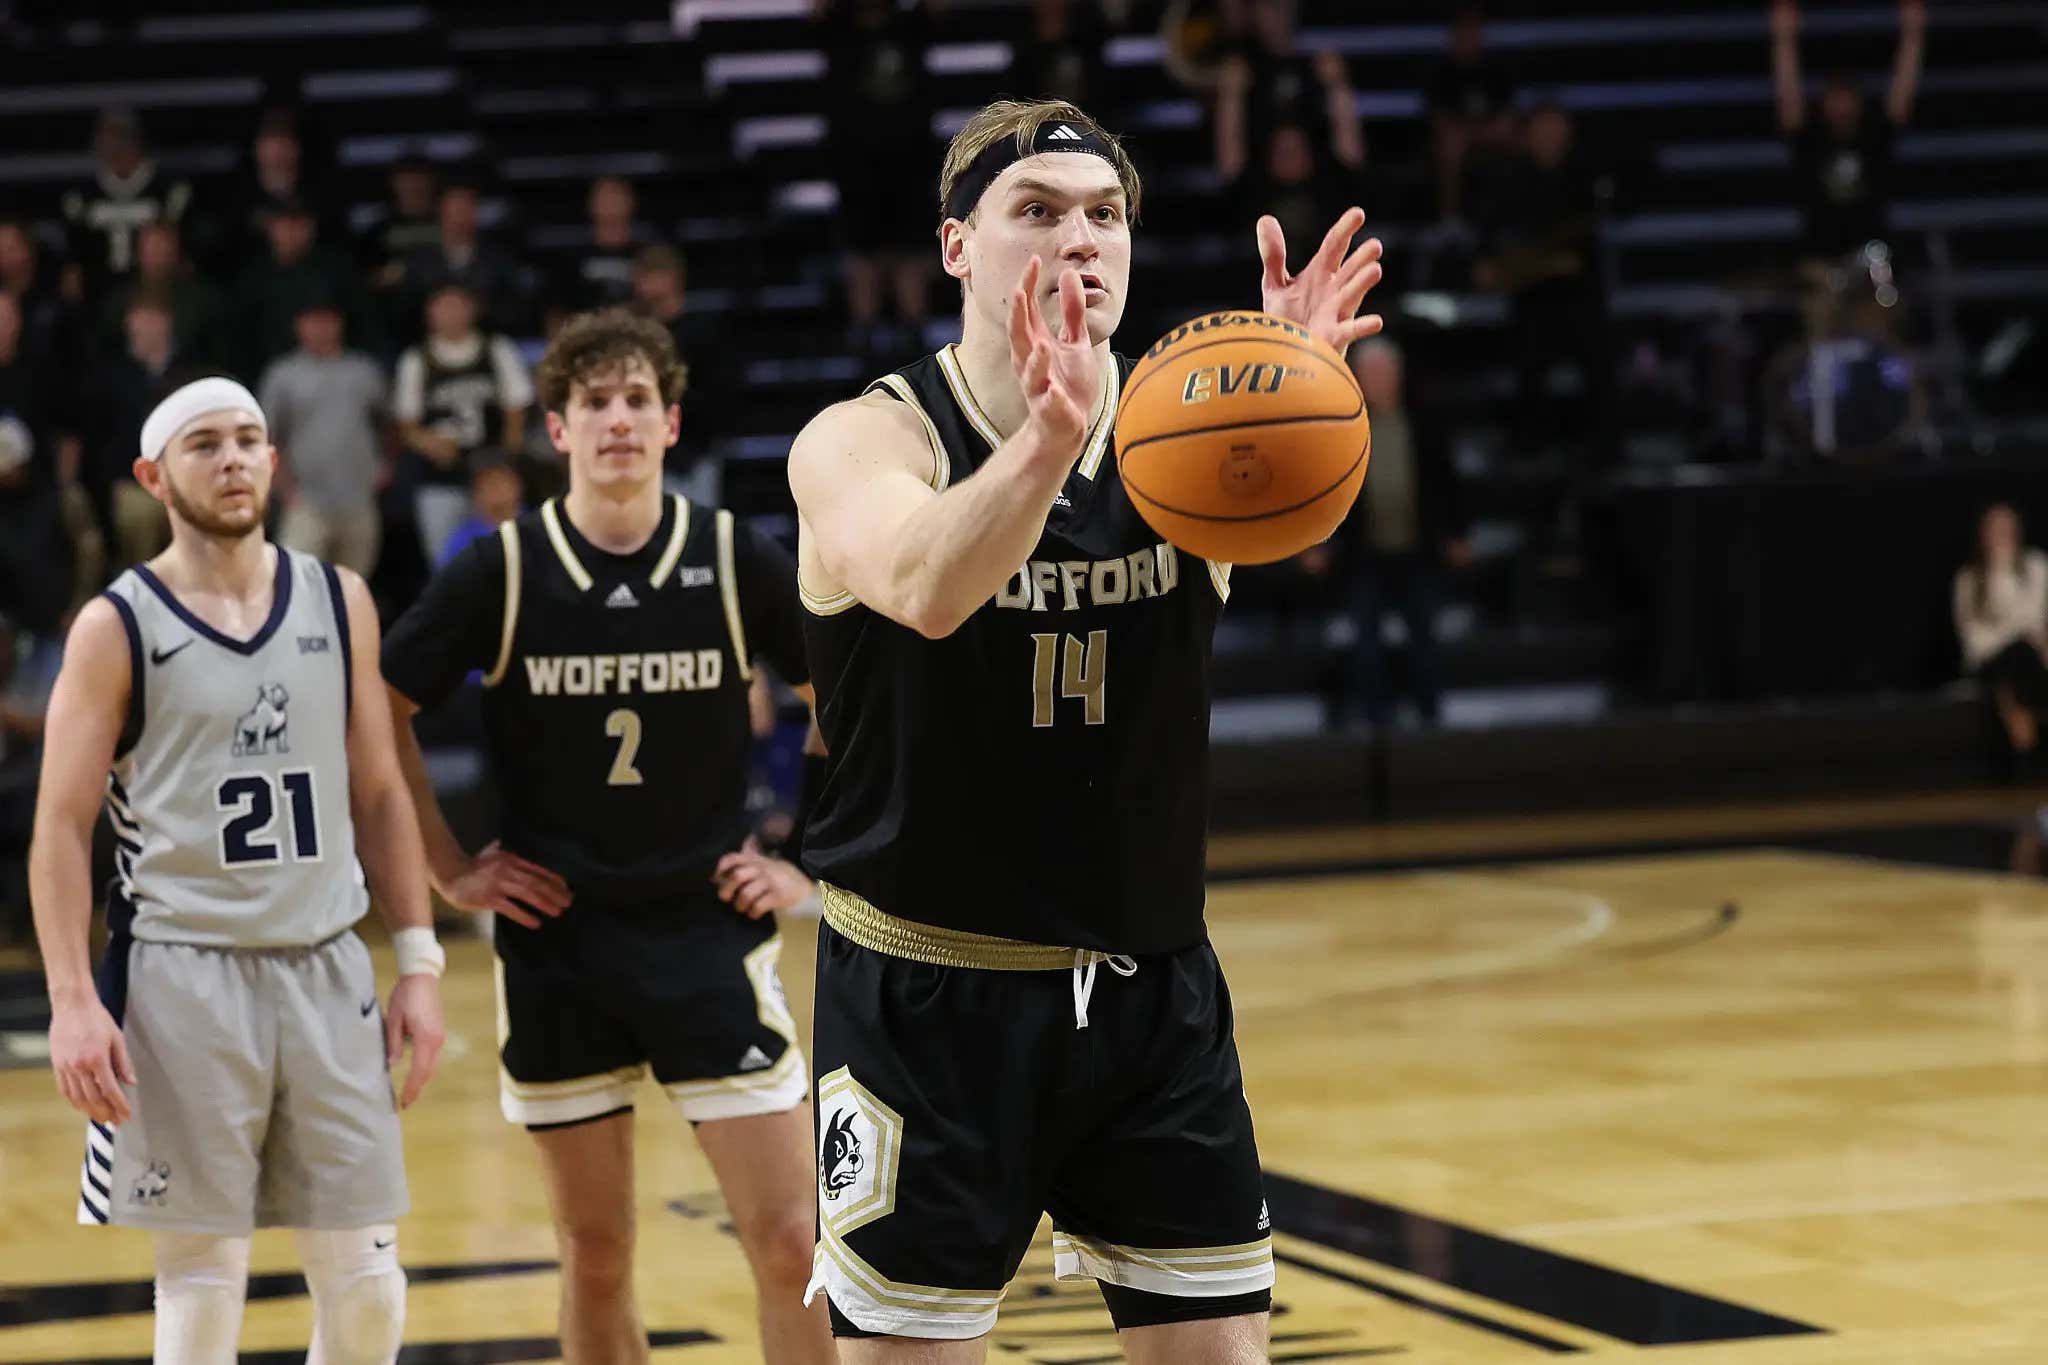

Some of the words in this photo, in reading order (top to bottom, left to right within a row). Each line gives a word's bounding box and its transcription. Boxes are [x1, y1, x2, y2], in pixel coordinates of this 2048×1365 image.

[1182, 363, 1286, 405] EVO
[996, 541, 1179, 612] OFFORD
[525, 649, 723, 696] WOFFORD
[1030, 629, 1107, 727] 14
[605, 708, 643, 786] 2
[215, 766, 323, 870] 21
